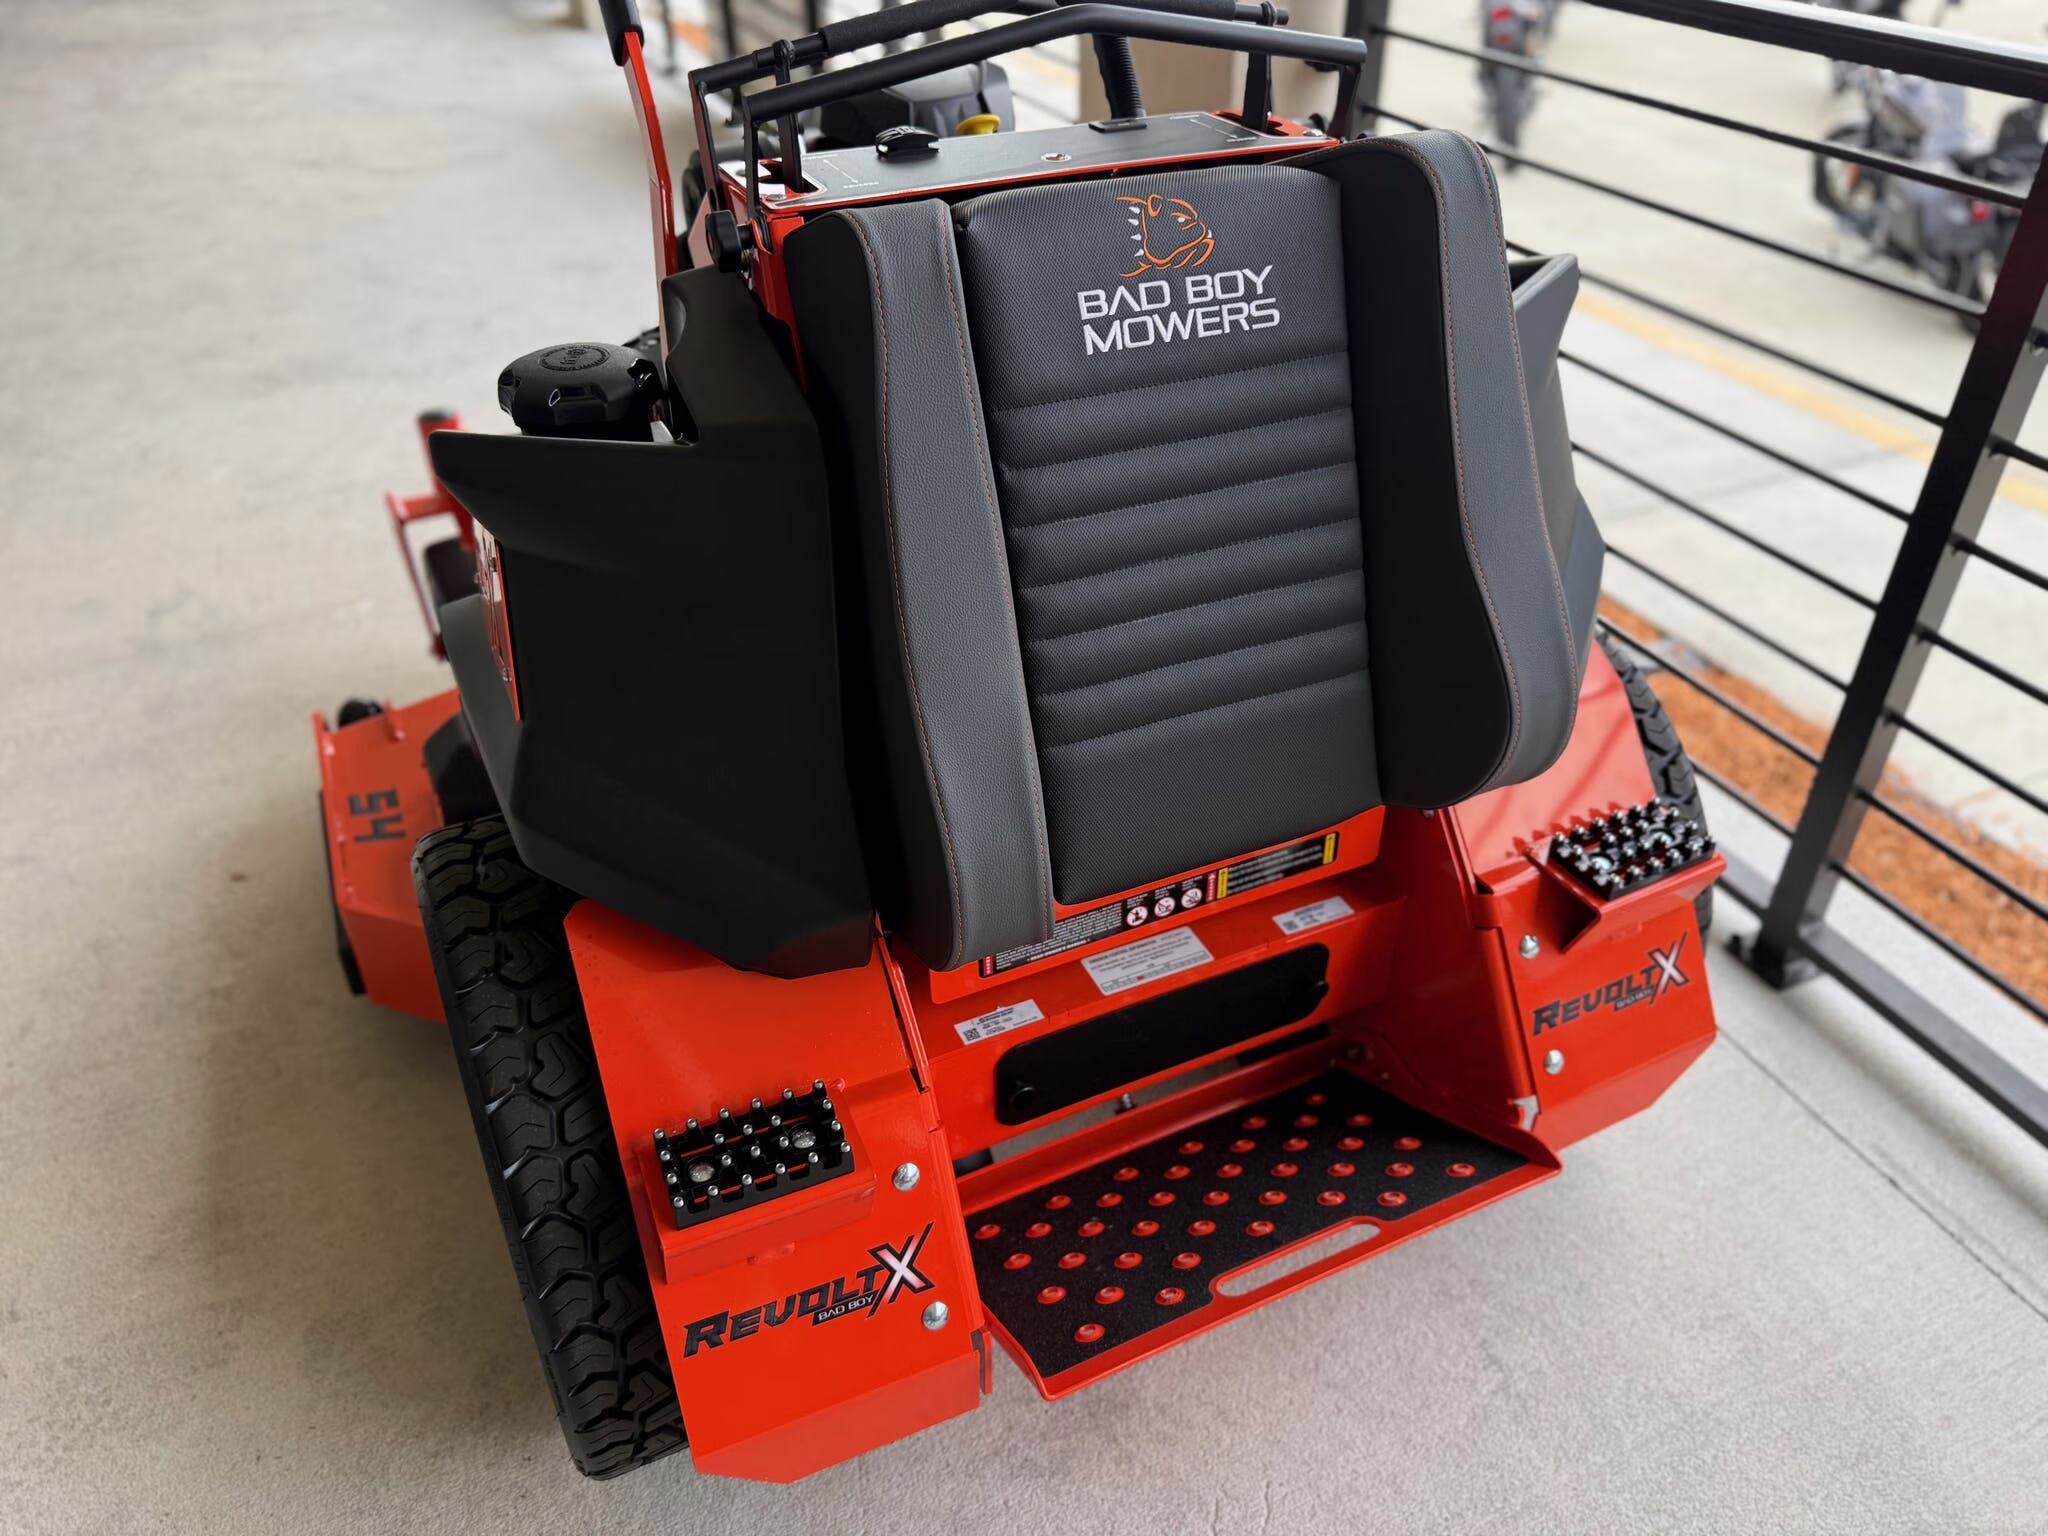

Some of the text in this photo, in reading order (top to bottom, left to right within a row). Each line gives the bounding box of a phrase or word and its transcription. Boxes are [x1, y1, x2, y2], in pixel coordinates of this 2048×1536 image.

[1077, 264, 1273, 320] BAD BOY
[1083, 297, 1280, 356] MOWERS
[348, 788, 406, 843] 54
[818, 1294, 874, 1321] BAD BOY
